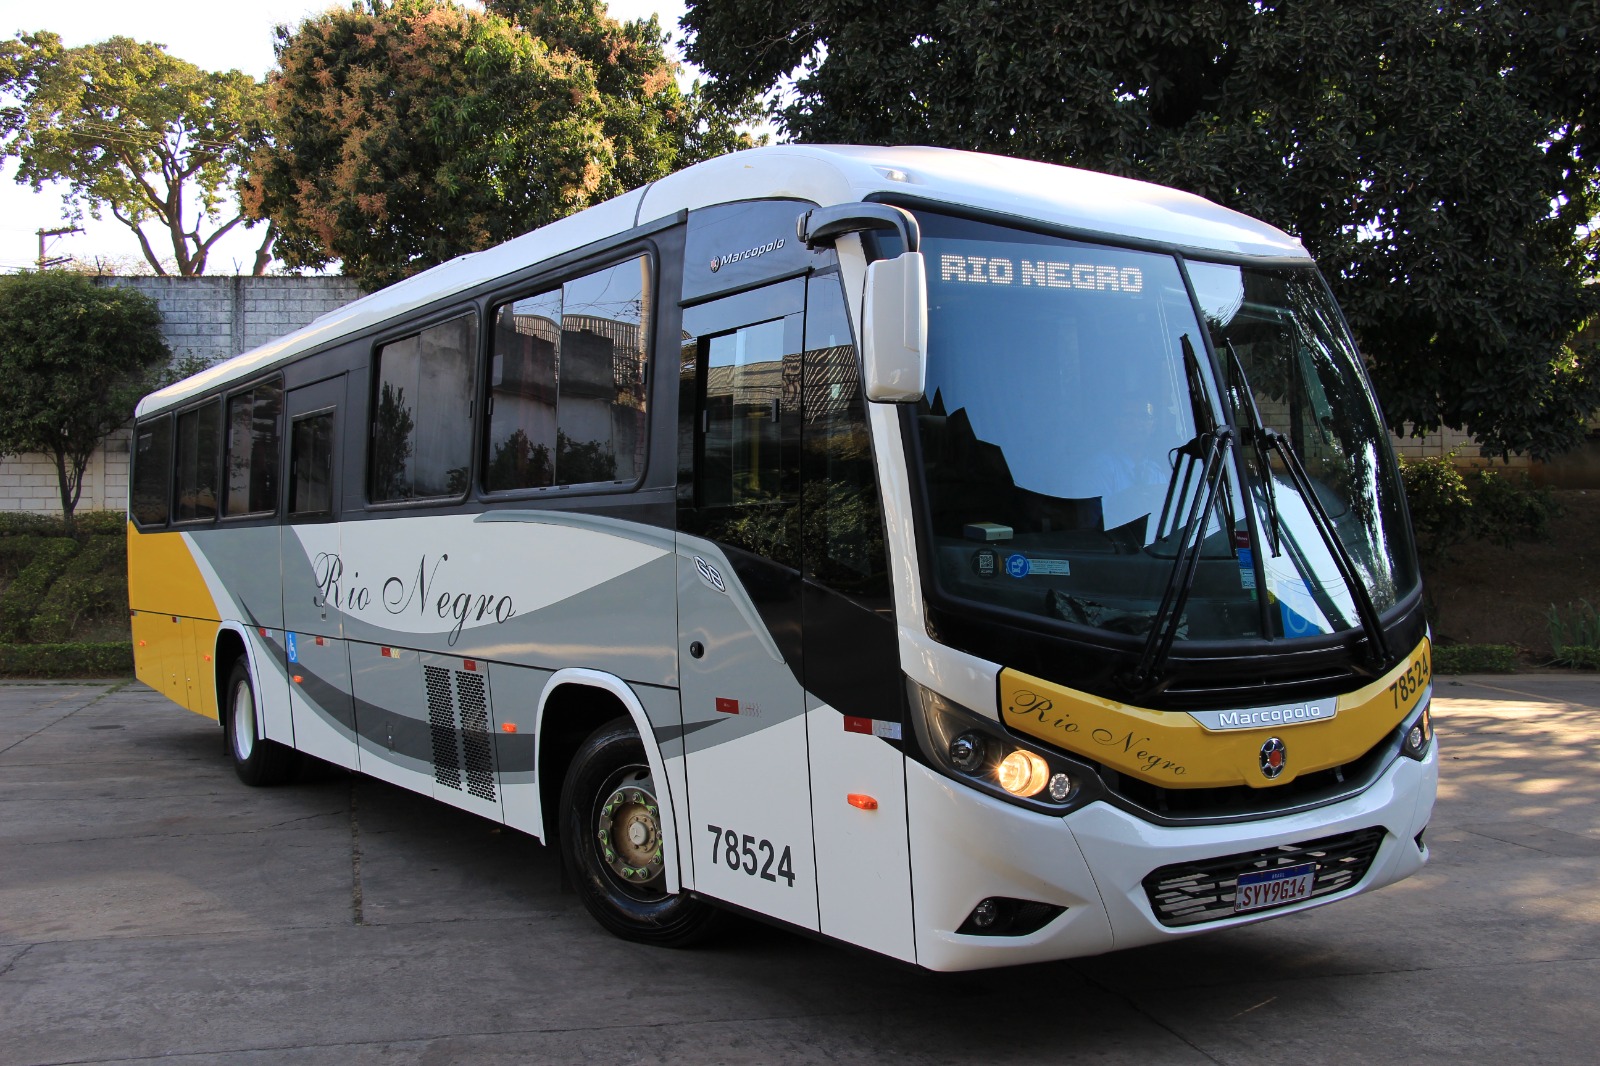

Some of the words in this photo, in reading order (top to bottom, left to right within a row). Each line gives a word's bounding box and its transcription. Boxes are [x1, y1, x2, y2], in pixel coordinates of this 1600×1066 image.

[720, 238, 785, 266] Marcopolo
[941, 254, 1013, 284] RIO
[1021, 260, 1143, 293] NEGRO
[313, 552, 371, 611] Rio
[382, 553, 516, 647] Negro
[1389, 652, 1429, 709] 78524
[1008, 689, 1081, 733] Rio
[1091, 728, 1188, 776] Negro
[1219, 704, 1320, 727] Marcopolo
[707, 824, 796, 888] 78524
[1242, 877, 1306, 907] SYY9G14
